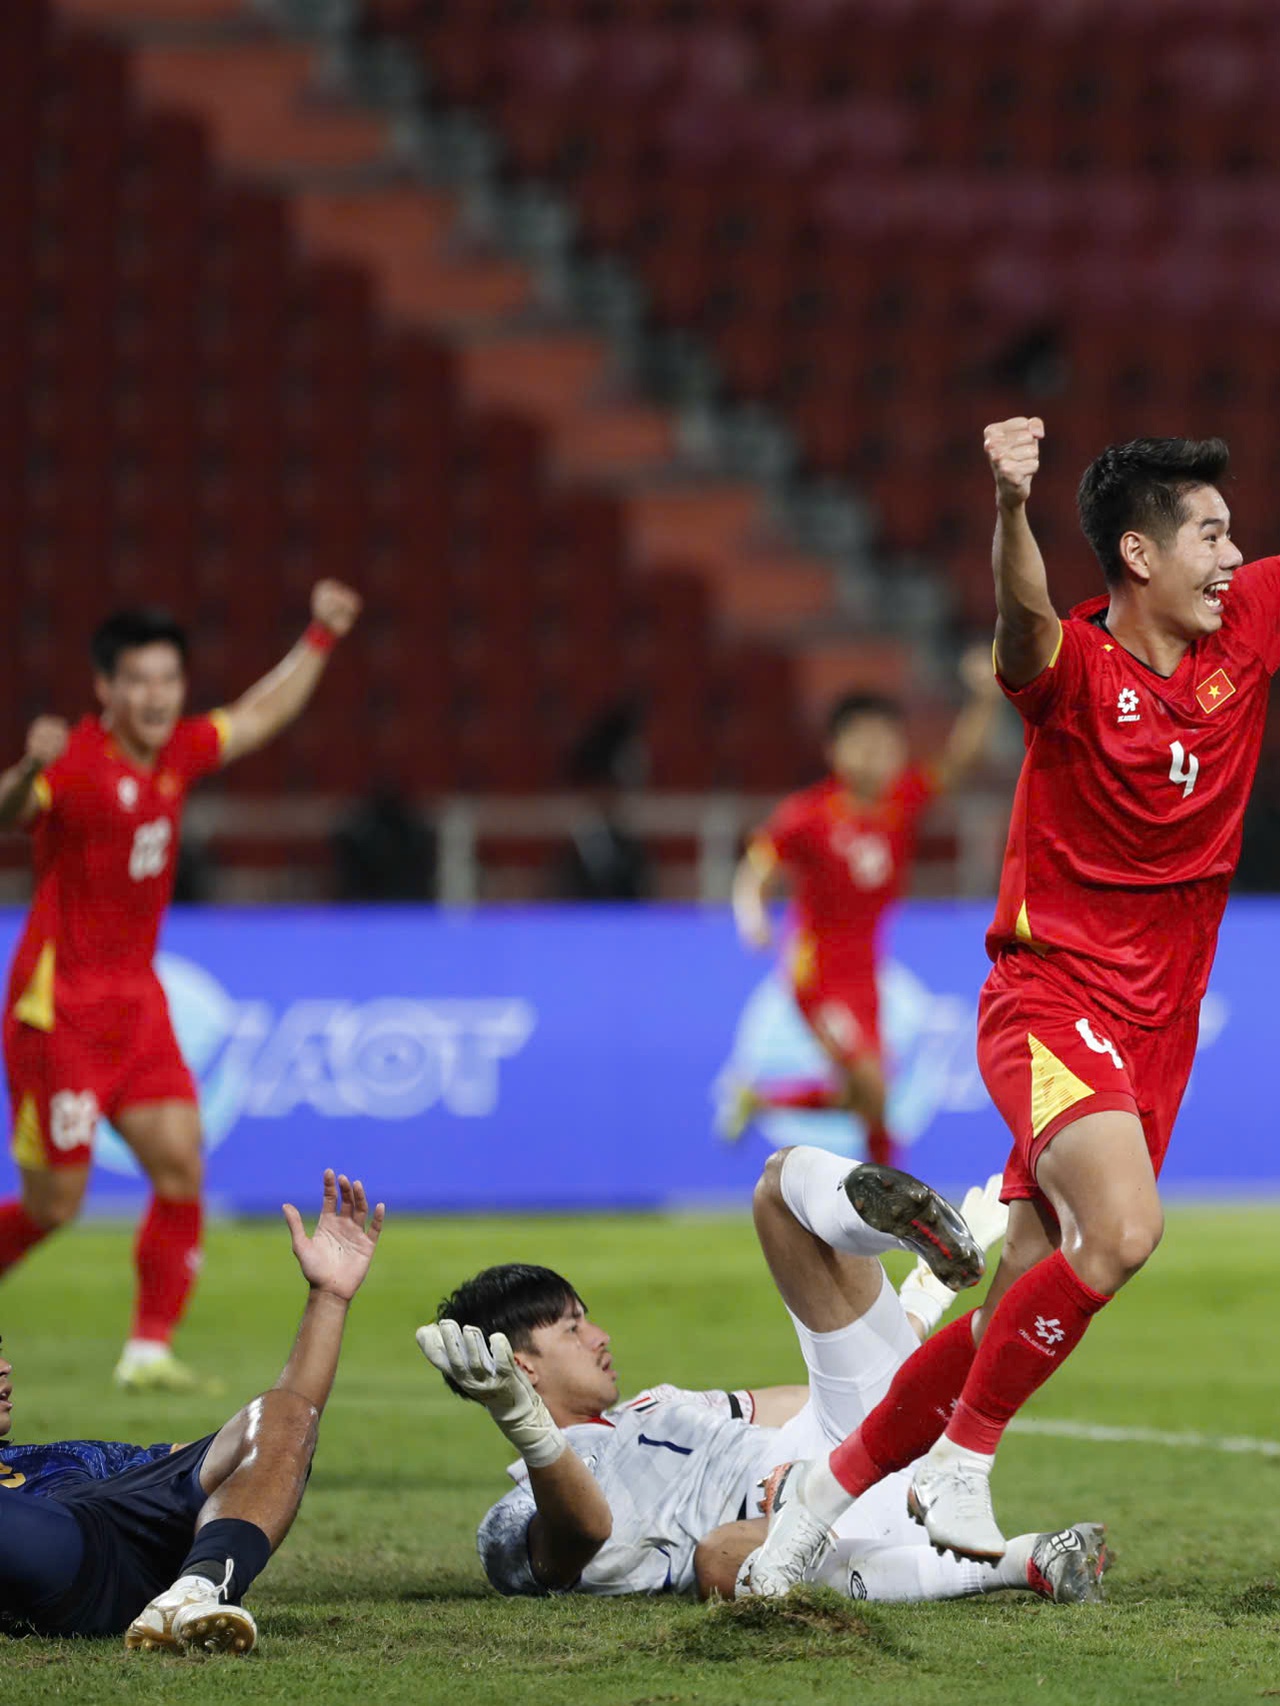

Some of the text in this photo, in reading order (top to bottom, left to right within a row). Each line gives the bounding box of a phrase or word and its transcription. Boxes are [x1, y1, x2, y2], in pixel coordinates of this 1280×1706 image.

[1168, 740, 1199, 799] 4
[1075, 1018, 1124, 1069] 4
[638, 1433, 694, 1456] 1
